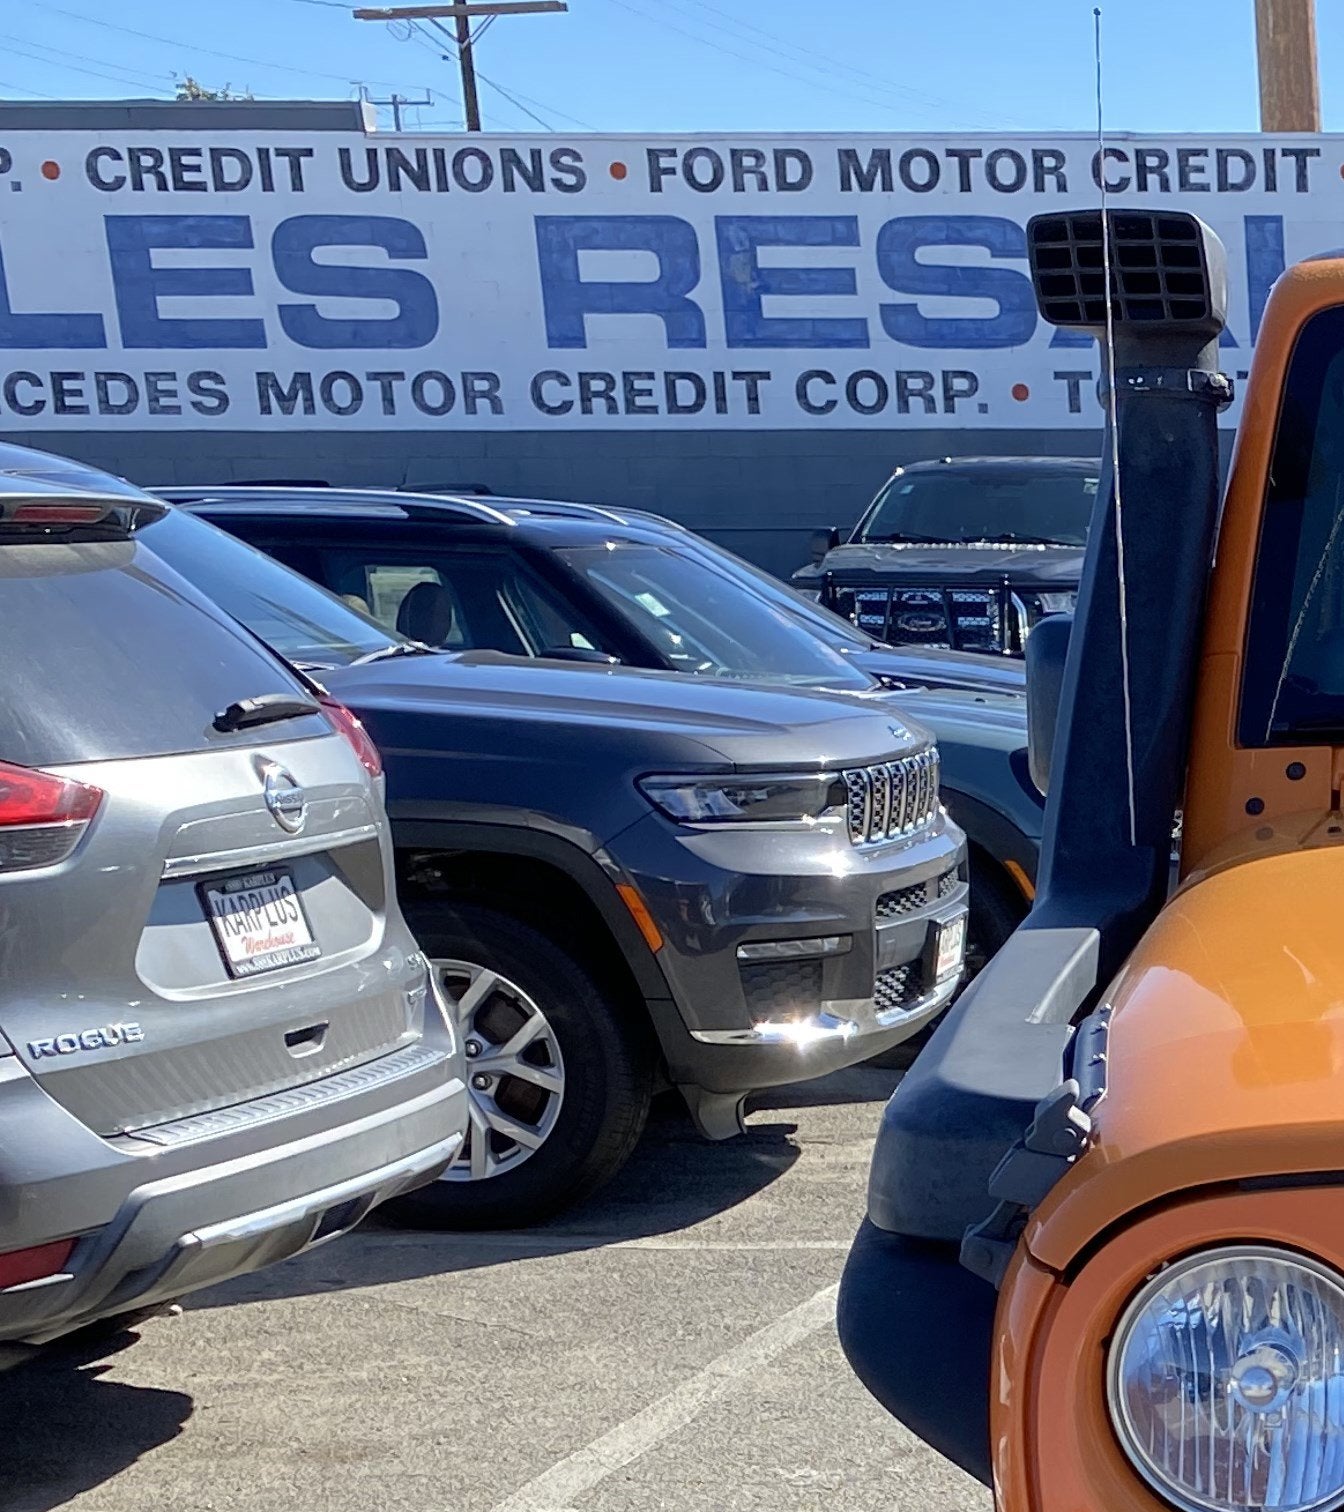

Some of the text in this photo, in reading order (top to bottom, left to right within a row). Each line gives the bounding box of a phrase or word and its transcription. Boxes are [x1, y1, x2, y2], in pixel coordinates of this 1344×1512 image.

[86, 147, 313, 192] CREDIT
[338, 147, 587, 193] UNIONS
[647, 147, 813, 193] FORD
[838, 147, 1067, 193] MOTOR
[1092, 147, 1320, 193] CREDIT
[256, 371, 503, 416] MOTOR
[531, 370, 771, 415] CREDIT
[796, 370, 989, 415] CORP.
[214, 885, 298, 938] KARPLUS
[27, 1022, 145, 1059] ROGUE
